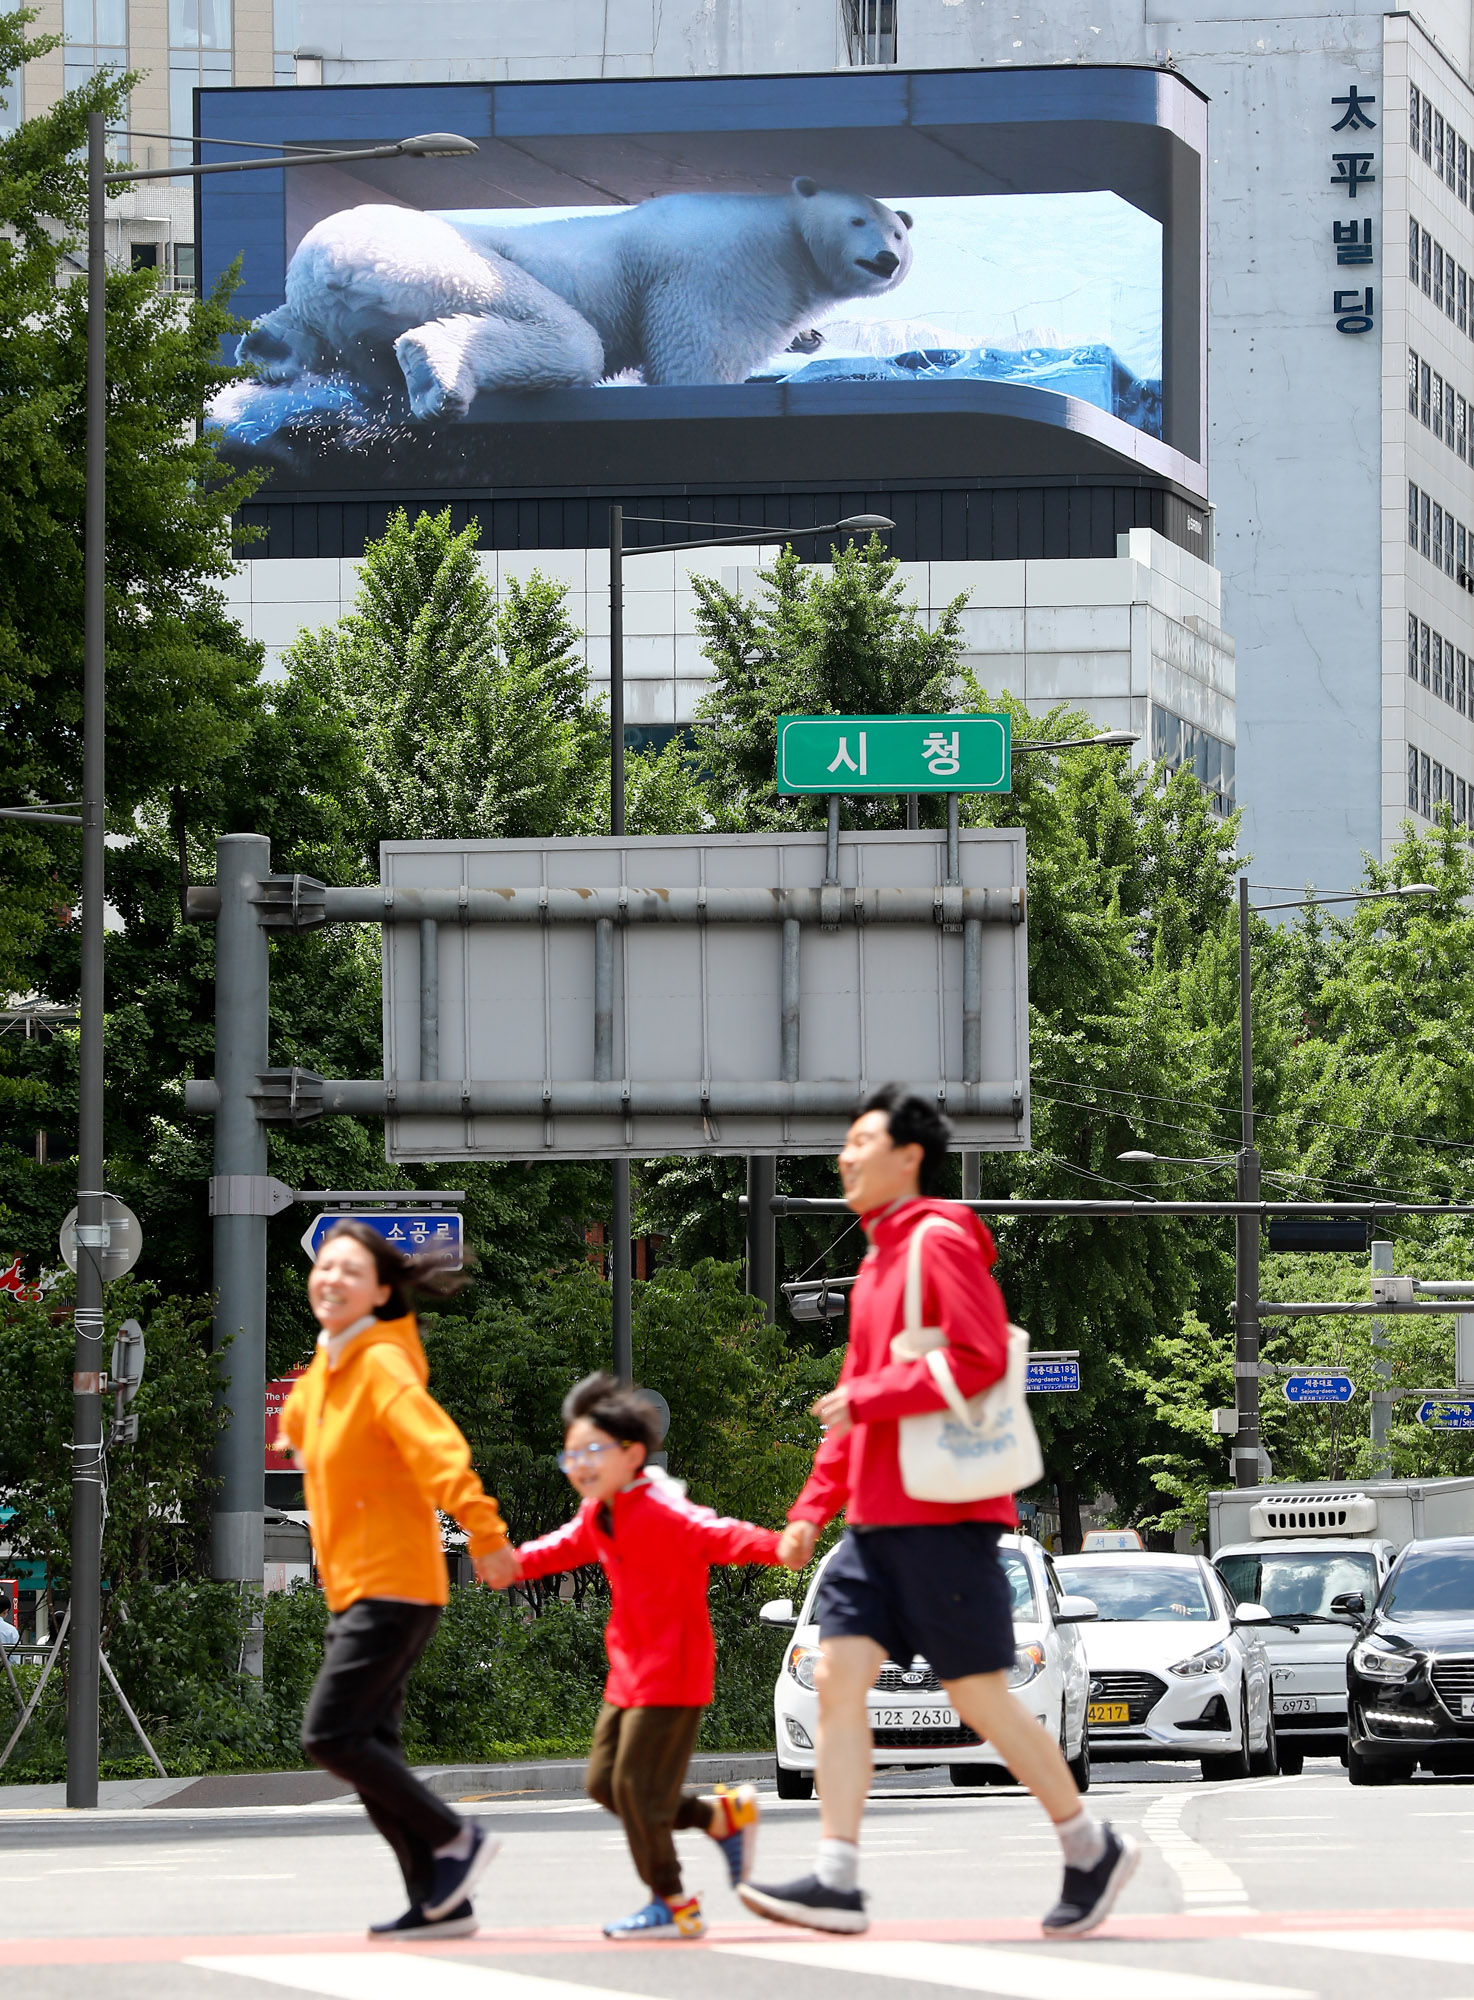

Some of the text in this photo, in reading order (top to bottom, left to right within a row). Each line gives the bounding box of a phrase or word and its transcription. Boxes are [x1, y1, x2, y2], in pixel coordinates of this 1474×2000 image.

[1331, 85, 1377, 334] 太平빌딩
[385, 1222, 453, 1244] 소공로
[265, 1392, 280, 1401] The
[1088, 1705, 1124, 1721] 4217
[1282, 1699, 1311, 1712] 6973
[874, 1709, 952, 1726] 12조 2630
